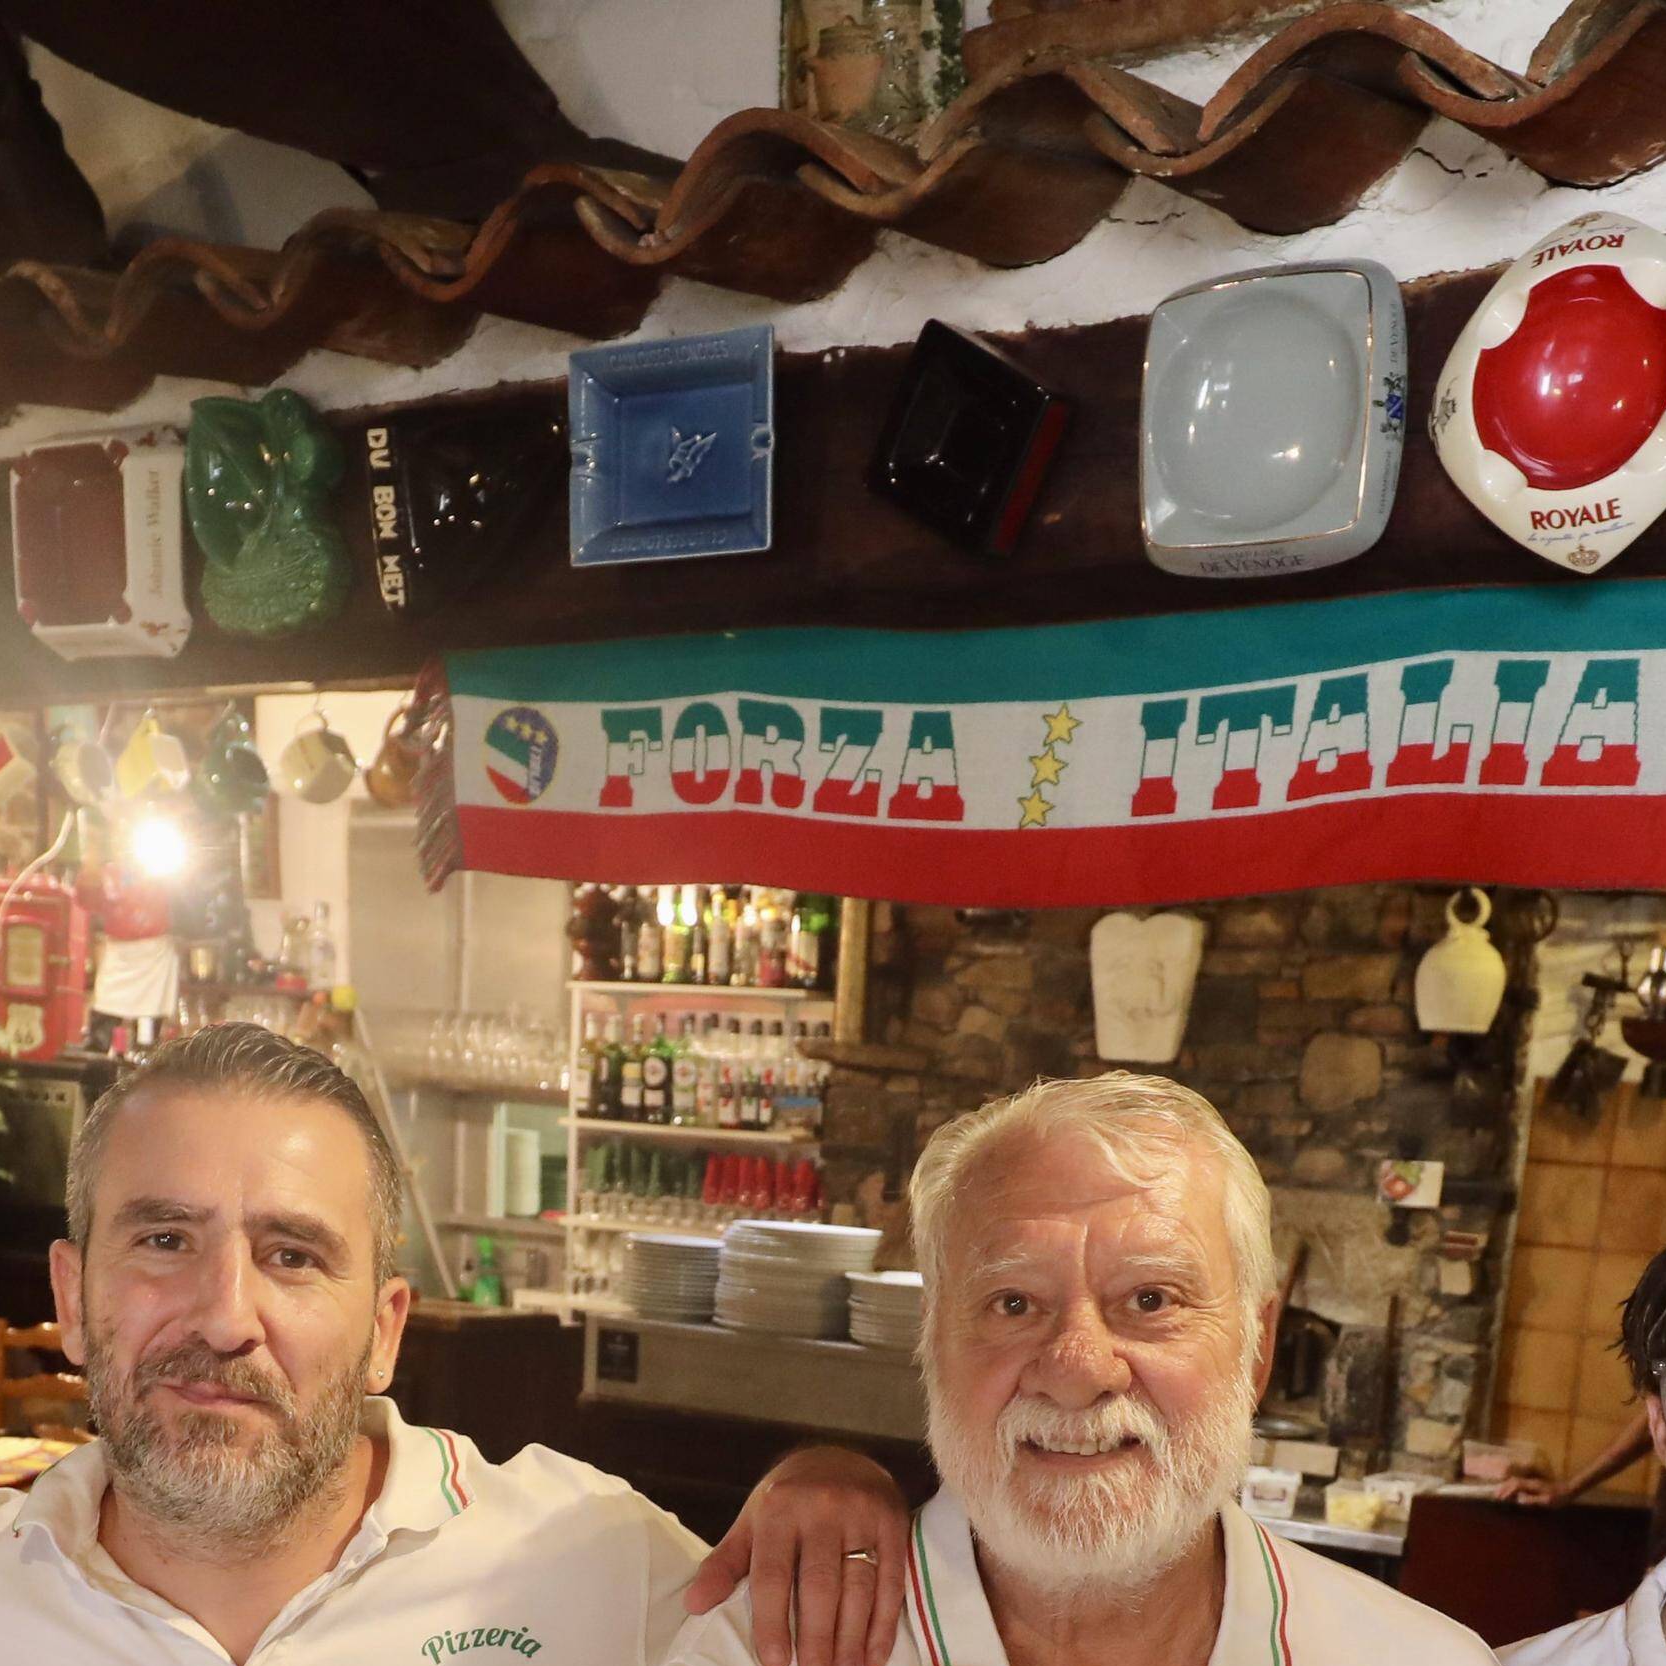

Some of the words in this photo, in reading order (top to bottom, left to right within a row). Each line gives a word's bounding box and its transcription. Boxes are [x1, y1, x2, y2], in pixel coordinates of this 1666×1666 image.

[1529, 234, 1625, 269] ROYALE
[1529, 497, 1623, 530] ROYALE
[598, 699, 965, 822] FORZA
[1130, 657, 1642, 818] ITALIA
[422, 1625, 543, 1665] Pizzeria
